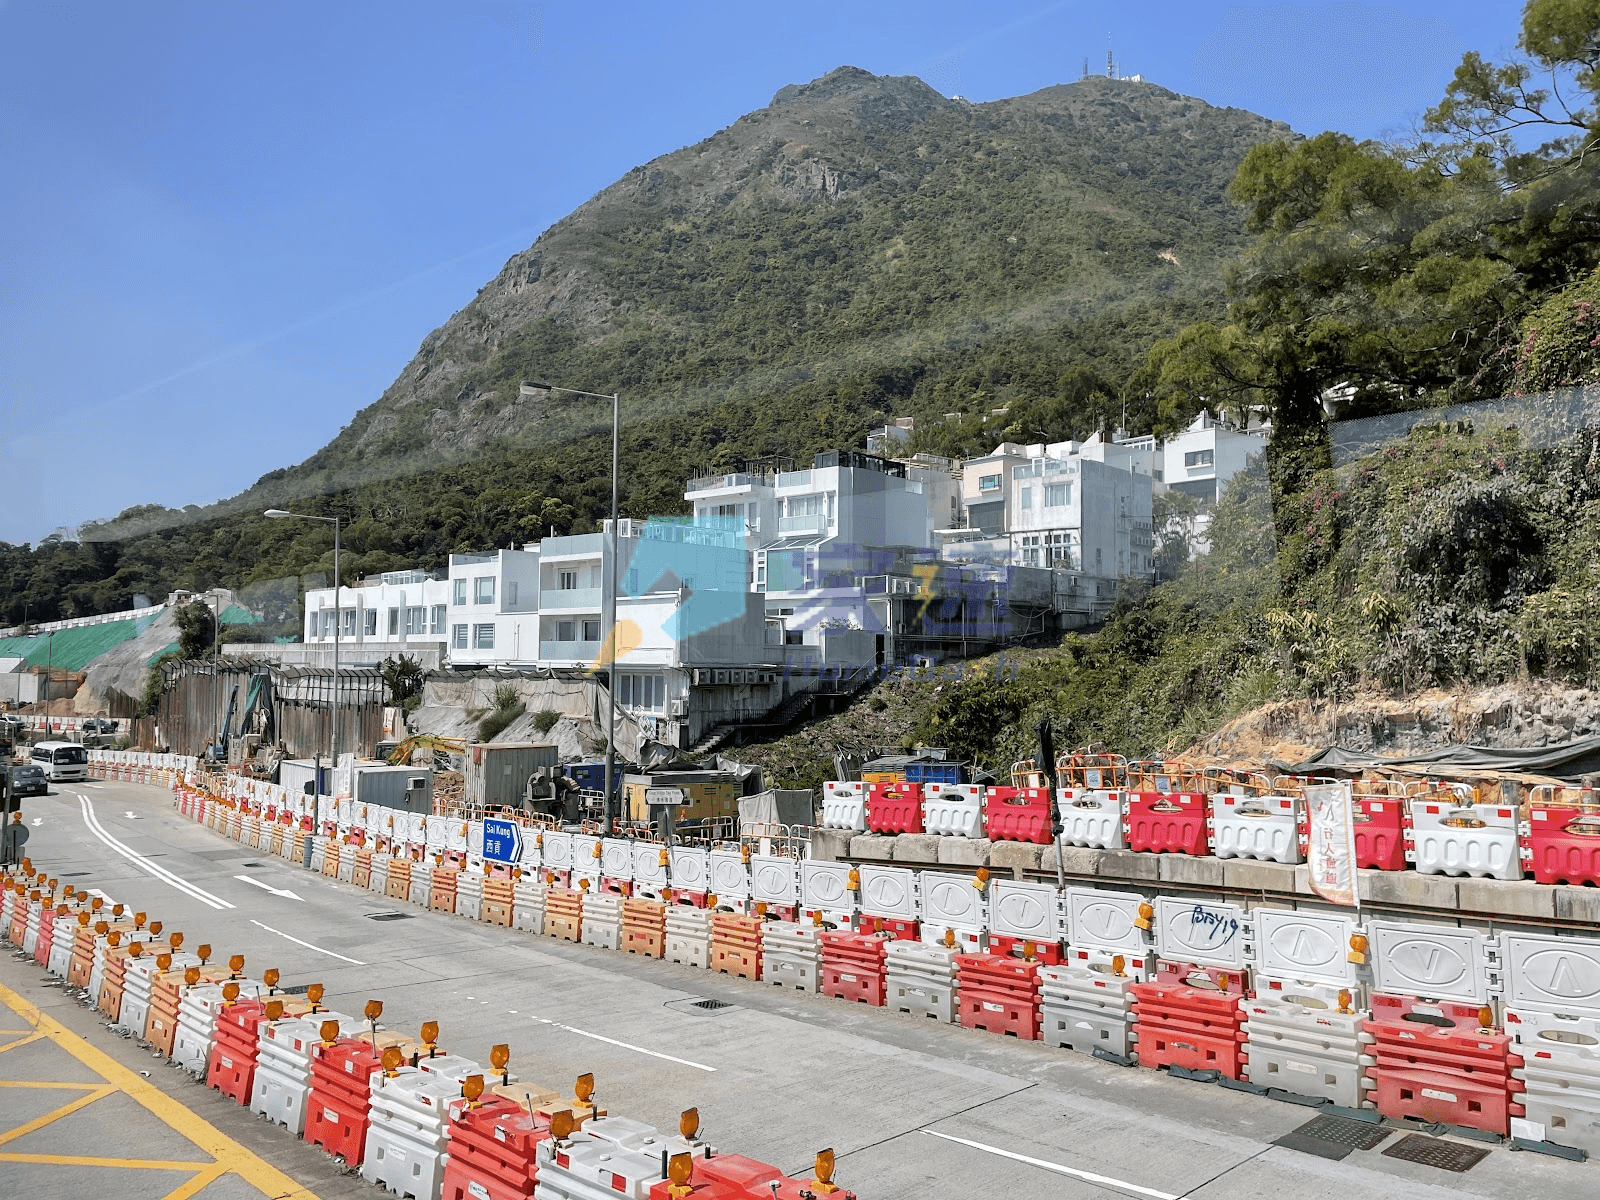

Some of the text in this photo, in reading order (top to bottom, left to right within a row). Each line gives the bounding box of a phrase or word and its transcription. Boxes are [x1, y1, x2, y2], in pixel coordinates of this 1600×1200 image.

[486, 823, 511, 839] Sai Kung
[486, 839, 501, 855] 西貢
